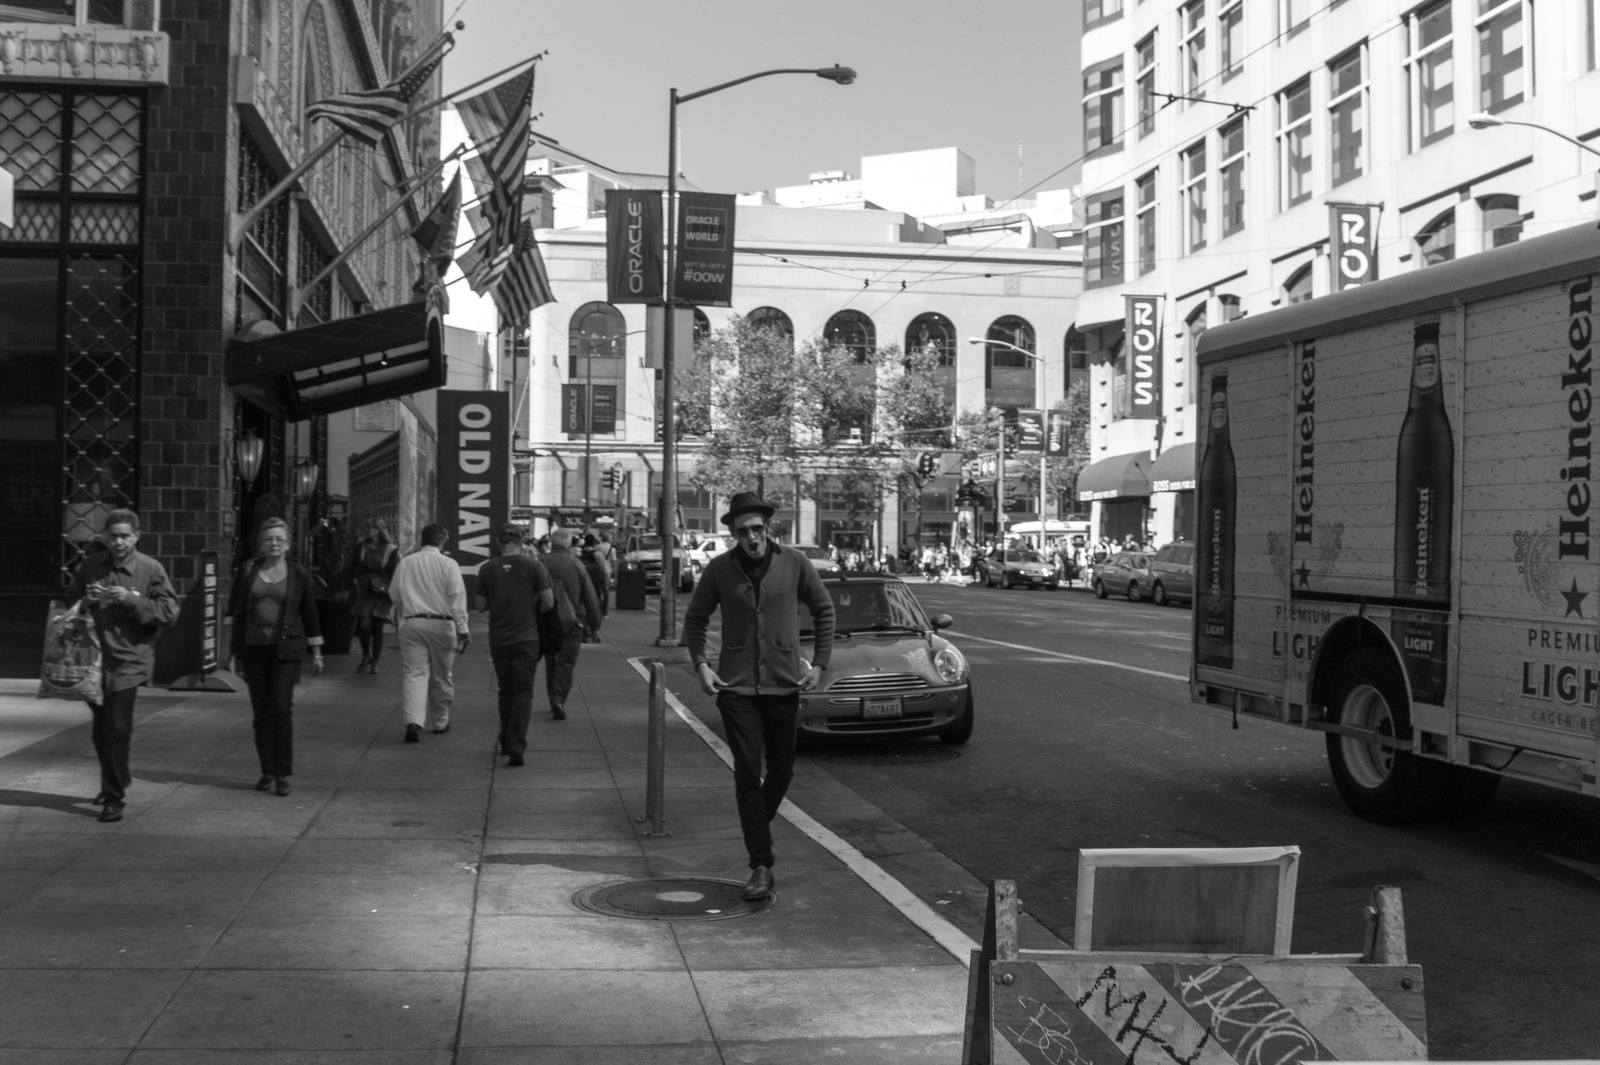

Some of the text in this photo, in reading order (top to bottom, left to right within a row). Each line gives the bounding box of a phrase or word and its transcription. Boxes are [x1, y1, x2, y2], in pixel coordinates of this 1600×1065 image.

[685, 232, 719, 241] WORLD
[686, 216, 720, 225] ORACLE
[692, 224, 725, 234] OPEN
[628, 200, 643, 293] ORACLE
[1340, 213, 1369, 290] RO
[683, 268, 725, 283] #OOW
[1133, 302, 1155, 405] ROSS
[1558, 275, 1593, 560] Heineken
[1294, 339, 1315, 545] Heineken
[458, 403, 492, 576] OLD NAVY
[1416, 486, 1430, 597] Heineken
[1205, 624, 1225, 636] LIGHT
[1404, 636, 1434, 652] LIGHT
[1532, 710, 1572, 728] LAGER
